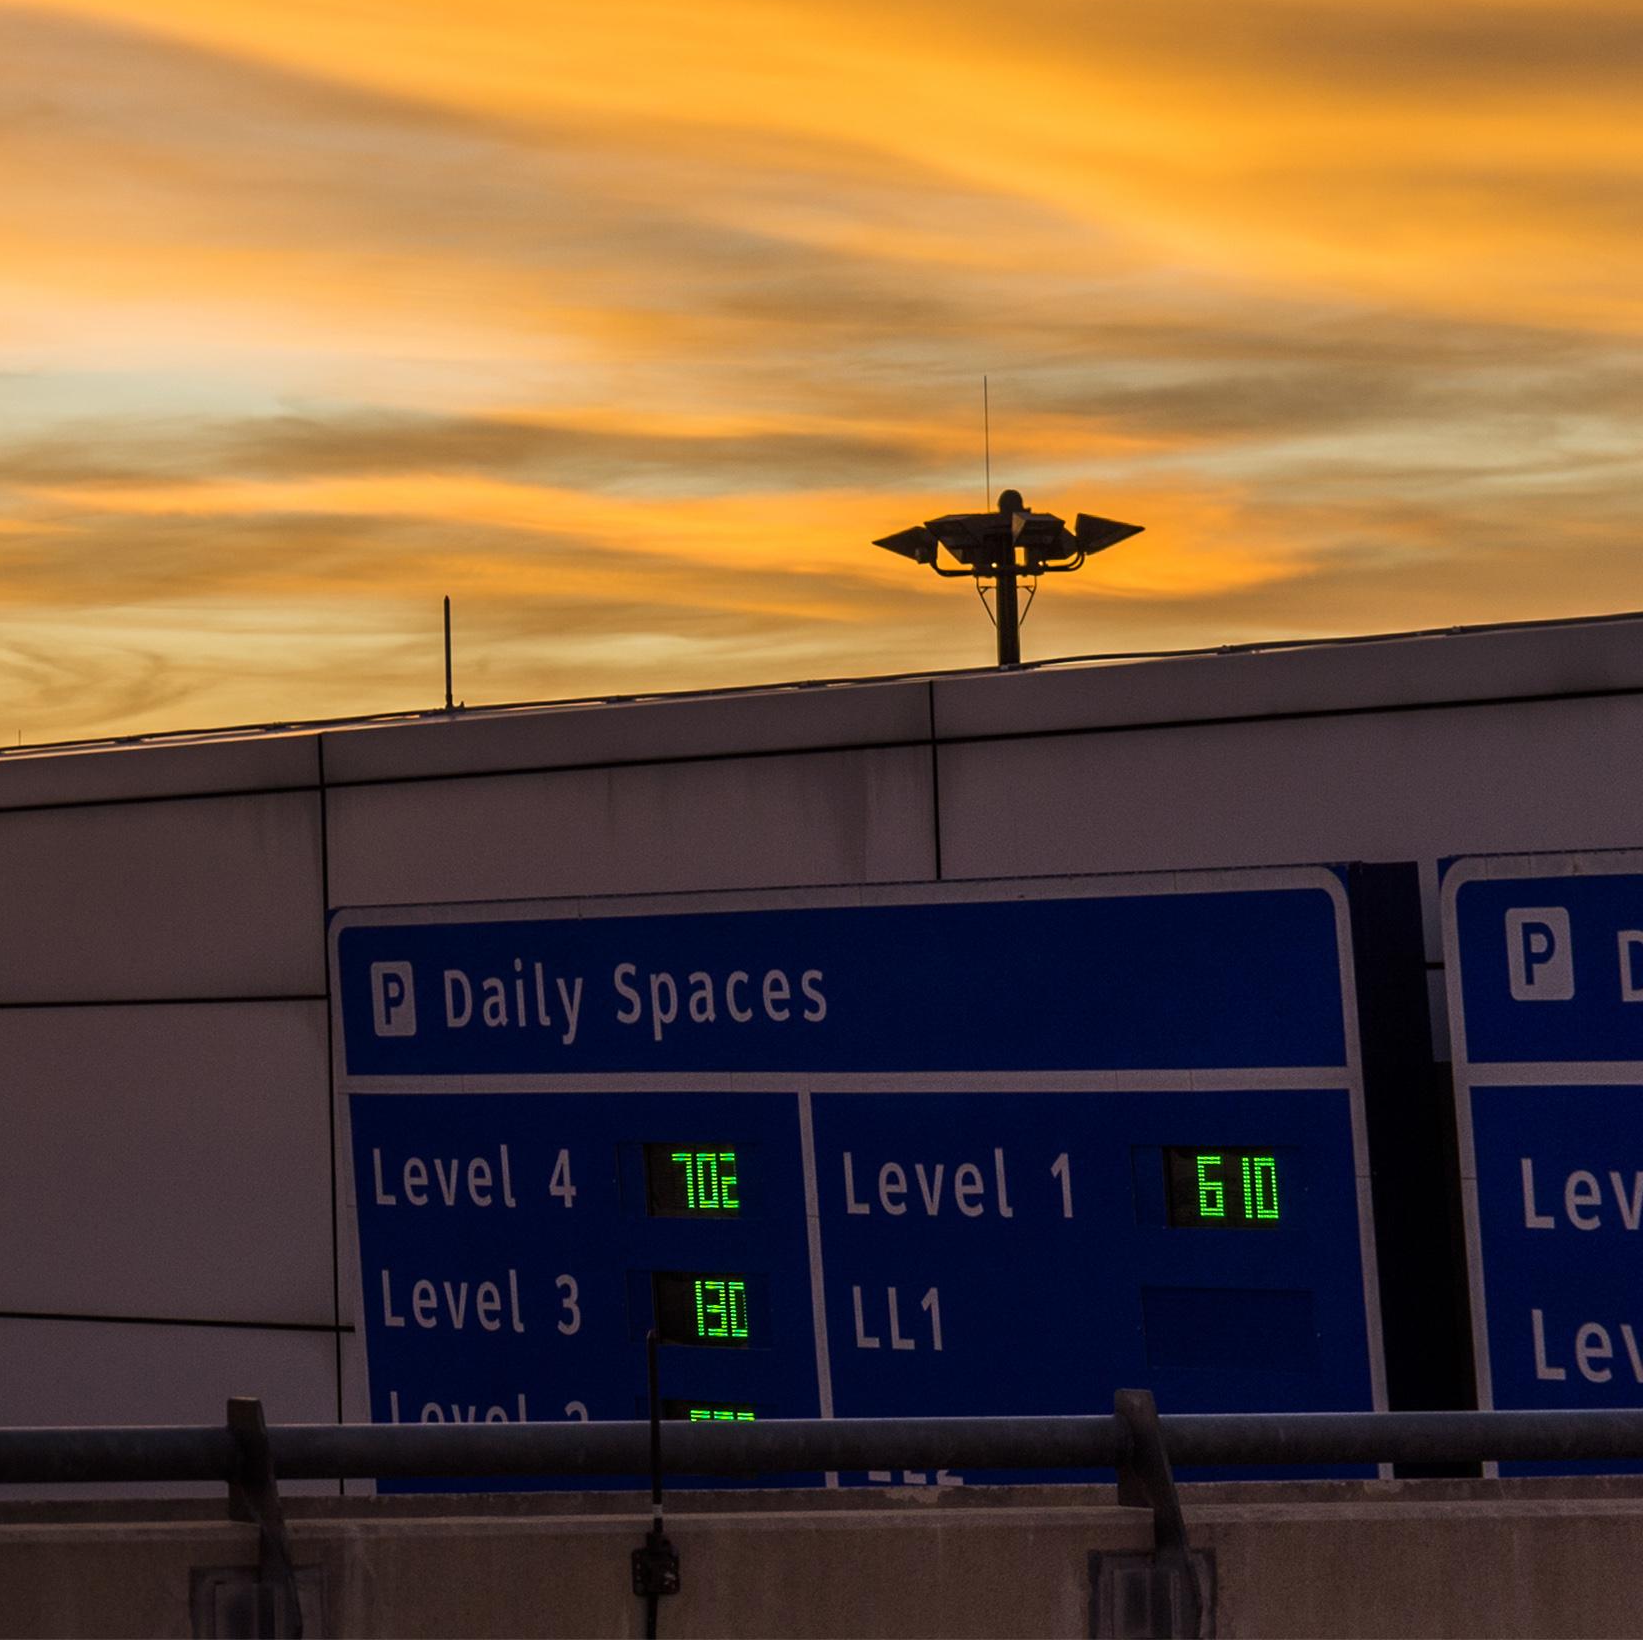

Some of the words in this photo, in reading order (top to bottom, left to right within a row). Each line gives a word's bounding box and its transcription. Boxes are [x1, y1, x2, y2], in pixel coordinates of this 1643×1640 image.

[443, 958, 583, 1045] Daily
[614, 962, 827, 1042] Spaces
[372, 1144, 517, 1208] Level
[548, 1148, 577, 1208] 4
[670, 1152, 740, 1210] 702
[843, 1147, 1013, 1218] Level
[1050, 1152, 1073, 1218] 1
[1196, 1155, 1280, 1220] 610
[381, 1268, 525, 1333] Level
[554, 1273, 581, 1335] 3
[694, 1280, 749, 1338] 130
[852, 1285, 943, 1351] LL1
